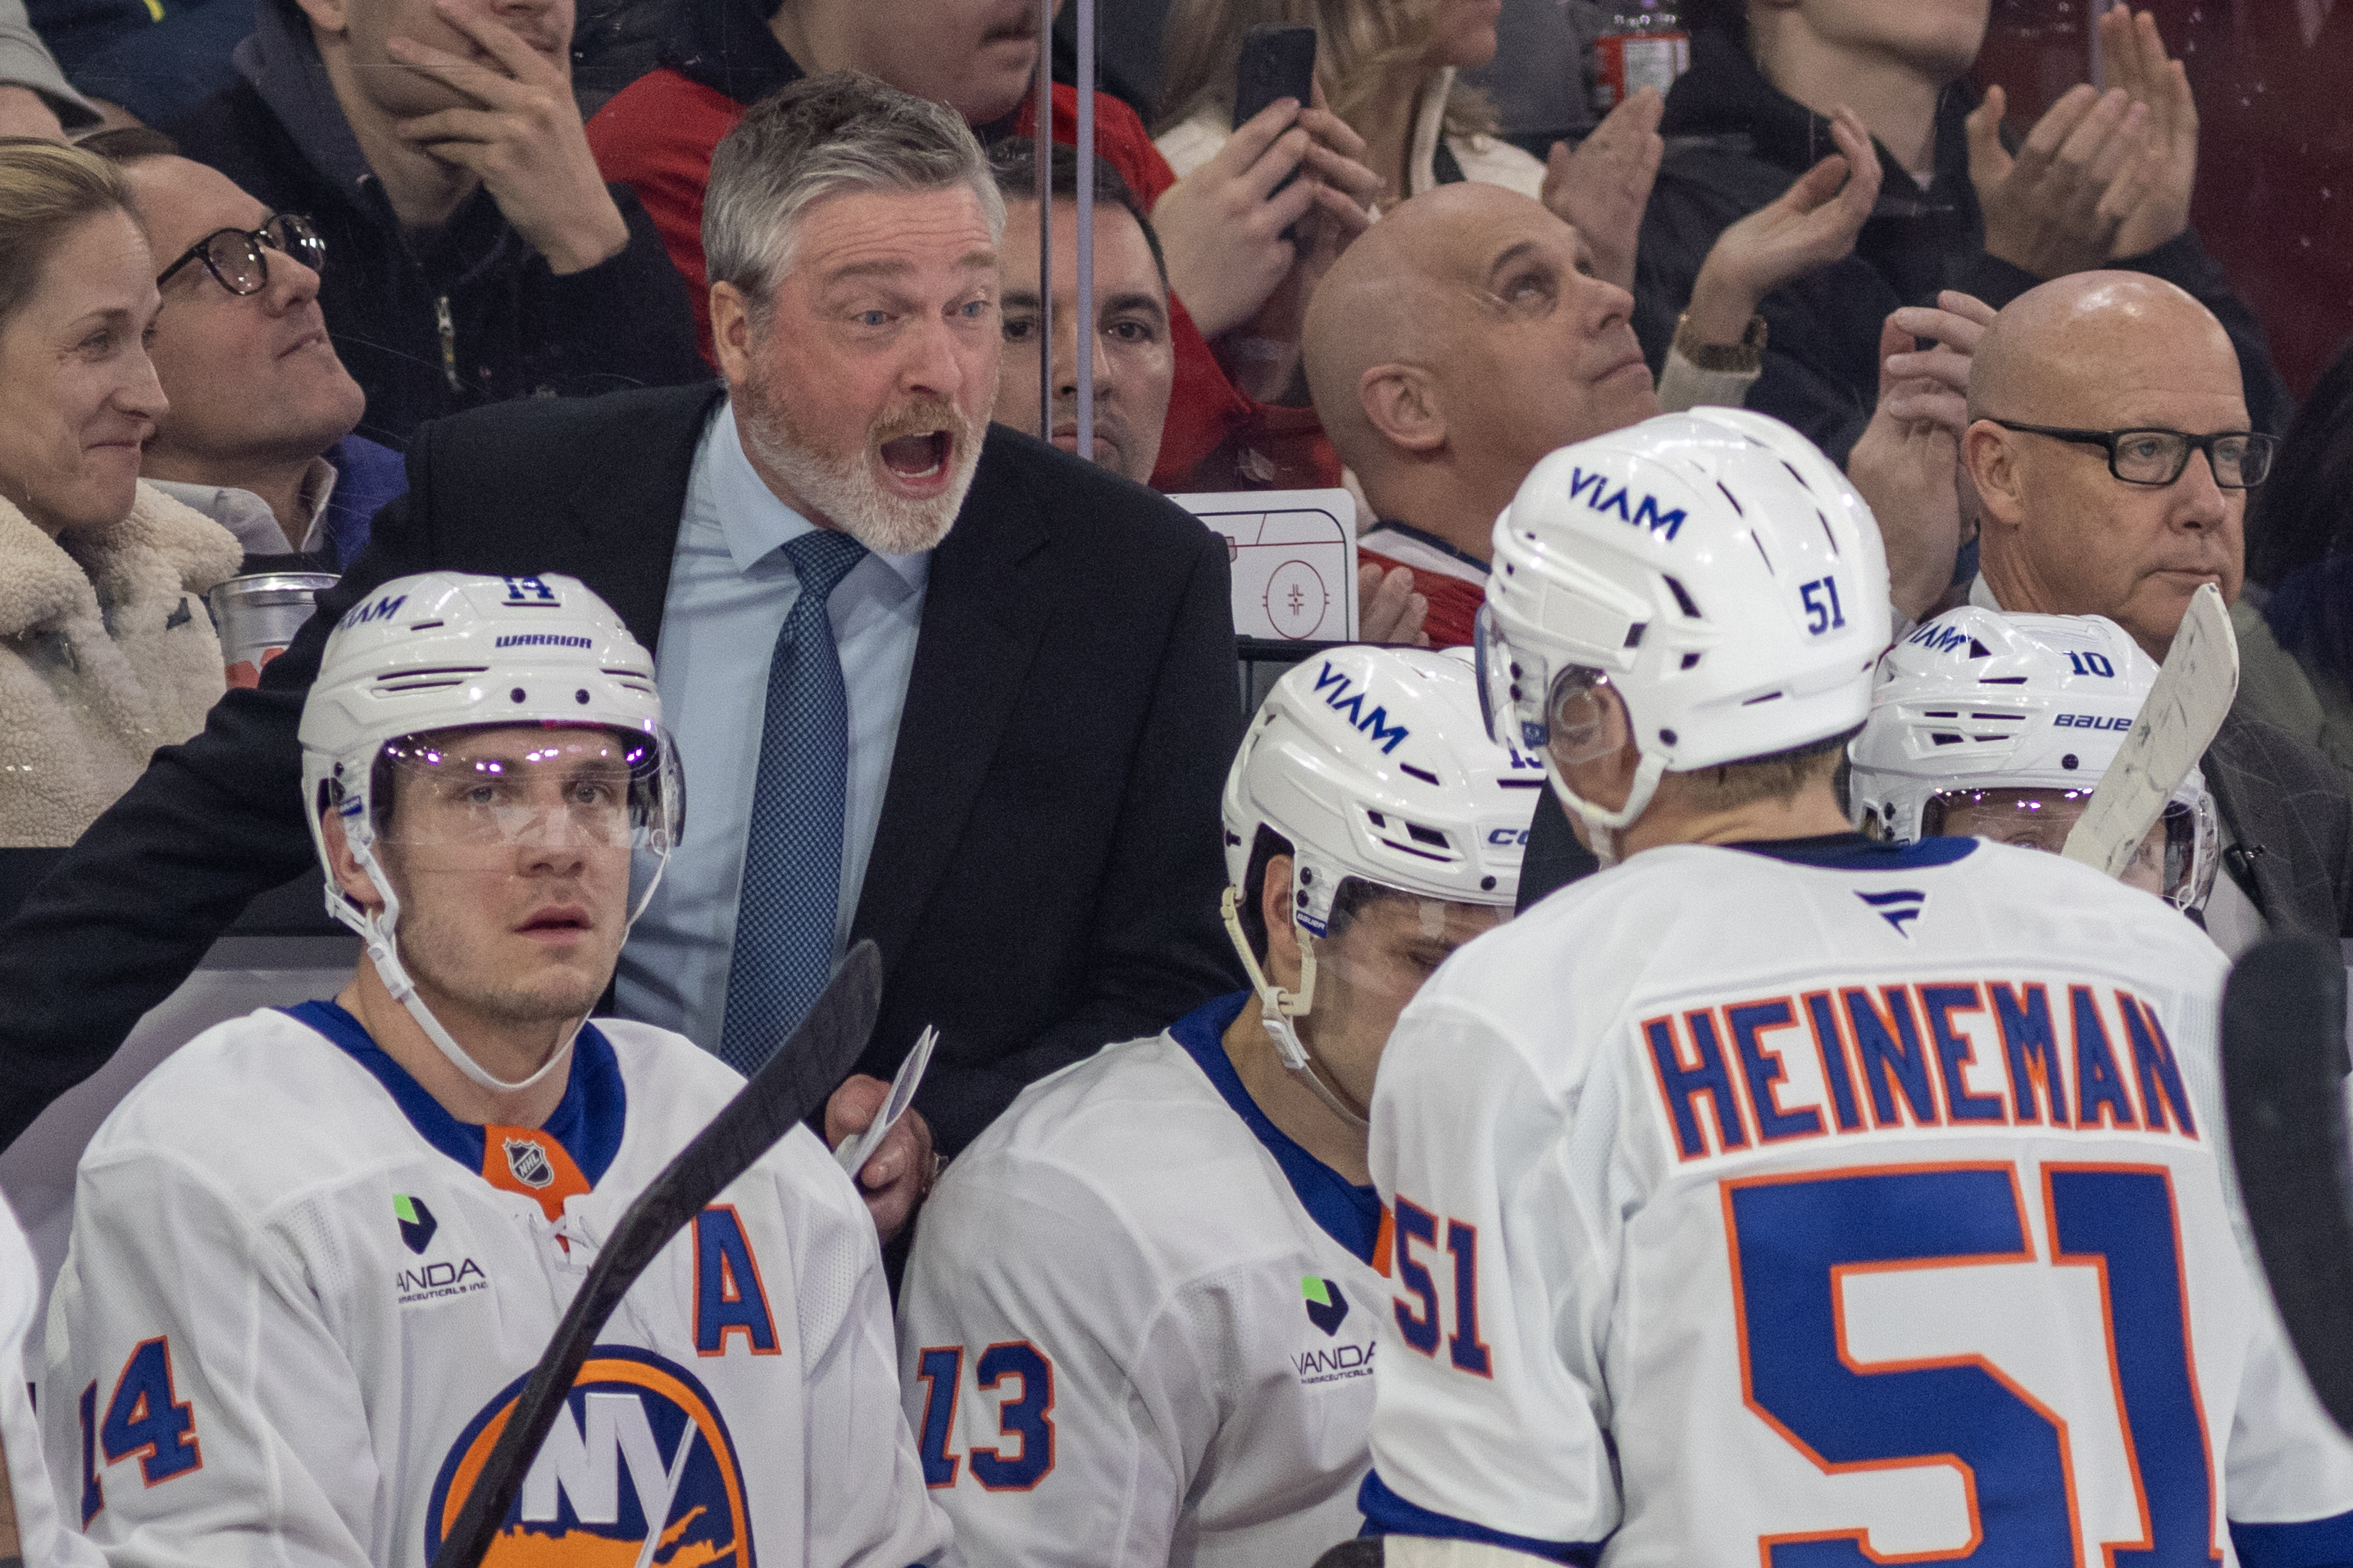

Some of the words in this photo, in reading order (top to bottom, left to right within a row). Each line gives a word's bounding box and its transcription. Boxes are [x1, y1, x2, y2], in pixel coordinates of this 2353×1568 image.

[1570, 467, 1688, 542] VIAM
[502, 576, 555, 600] 14
[1800, 575, 1846, 636] 51
[495, 634, 592, 649] WARRIOR
[1908, 621, 1971, 653] IAM
[2062, 650, 2115, 679] 10
[1313, 660, 1409, 756] VIAM
[2054, 714, 2133, 732] BAUE
[1641, 980, 2201, 1164] HEINEMAN
[519, 1152, 540, 1177] NHL
[397, 1258, 486, 1293] ANDA
[691, 1203, 782, 1357] A
[1393, 1193, 1494, 1380] 51
[1718, 1159, 2224, 1568] 51
[79, 1334, 203, 1535] 14
[916, 1339, 1056, 1493] 13
